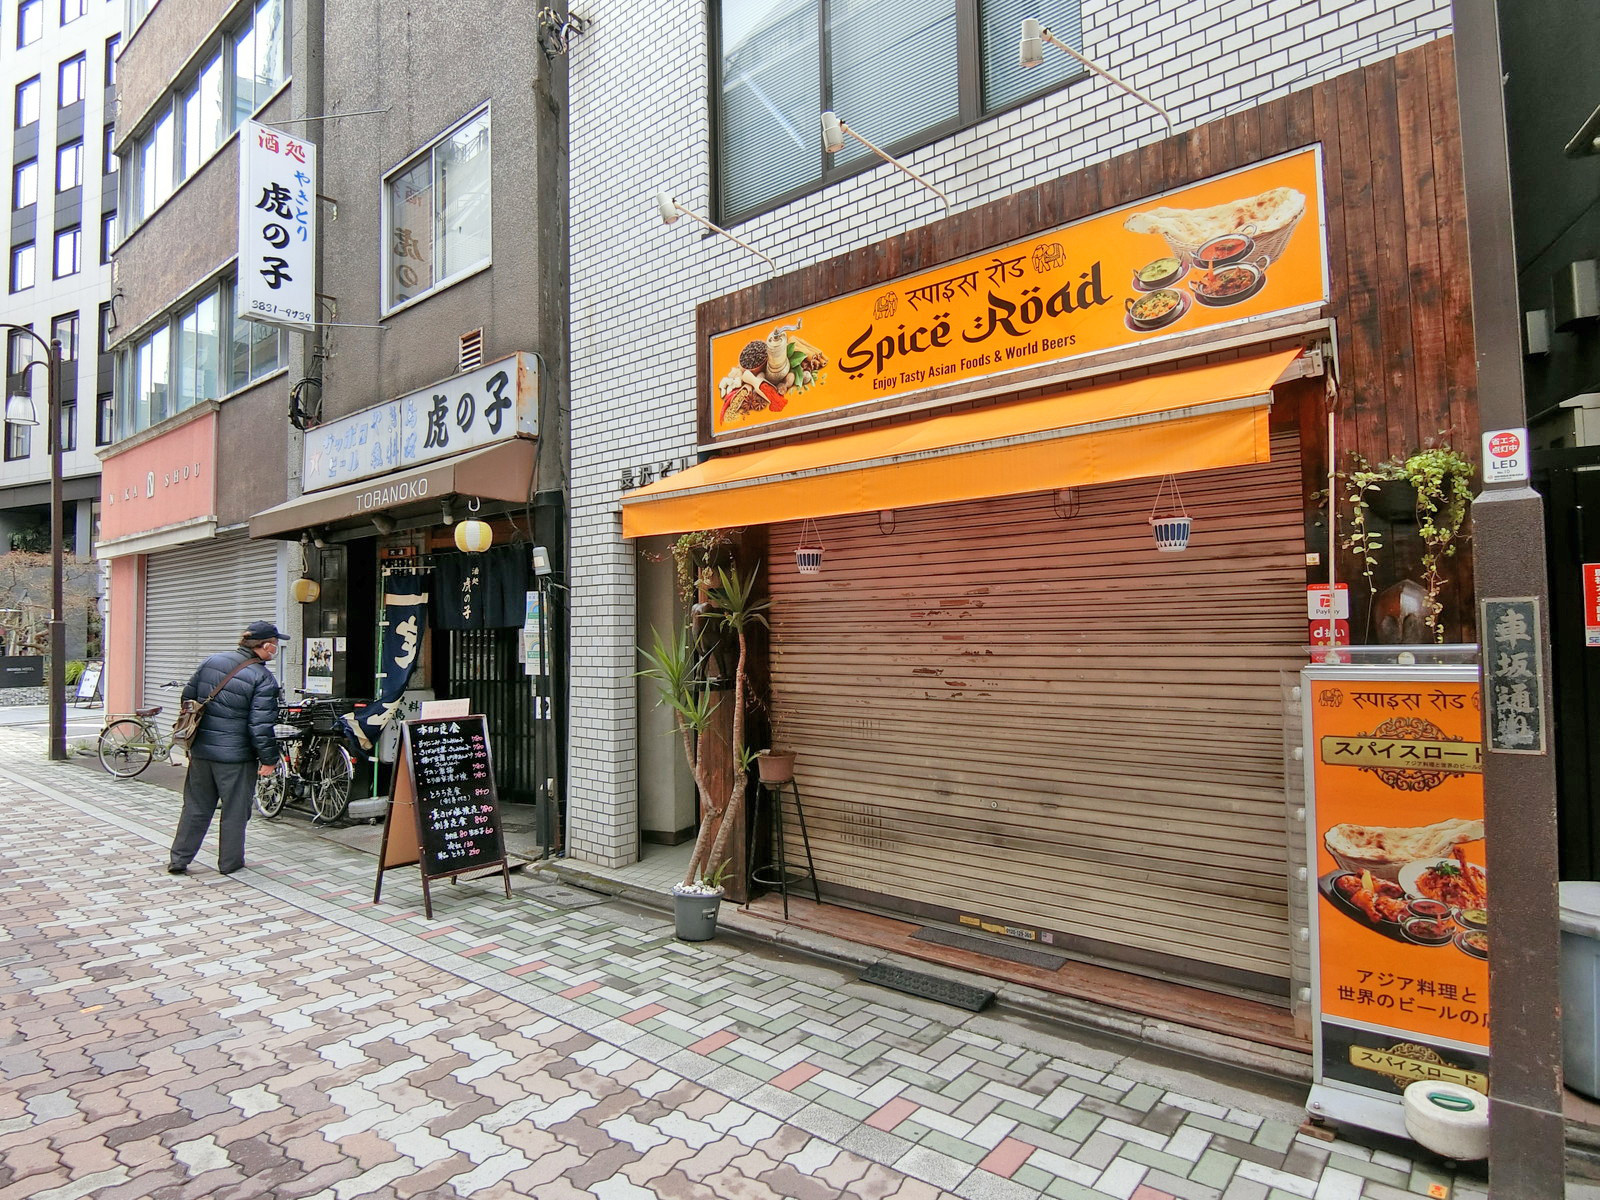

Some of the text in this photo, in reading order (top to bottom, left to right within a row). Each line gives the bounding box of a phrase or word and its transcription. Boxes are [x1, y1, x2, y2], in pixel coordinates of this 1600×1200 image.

[258, 128, 306, 164] 酒処
[294, 170, 311, 242] やきとり
[255, 182, 294, 290] 虎の子
[873, 334, 1076, 390] Enjoy Tasty Asian Foods & World Beers
[423, 370, 512, 449] 虎の子
[1491, 436, 1518, 446] 省エネ
[1491, 444, 1518, 454] 点灯中
[164, 462, 200, 488] SHOU
[1492, 459, 1518, 470] LED
[356, 478, 428, 511] TORANOKO
[1316, 608, 1340, 616] PayPy
[1357, 969, 1476, 1004] アジア料理と
[1361, 1051, 1478, 1085] スパイスロード
